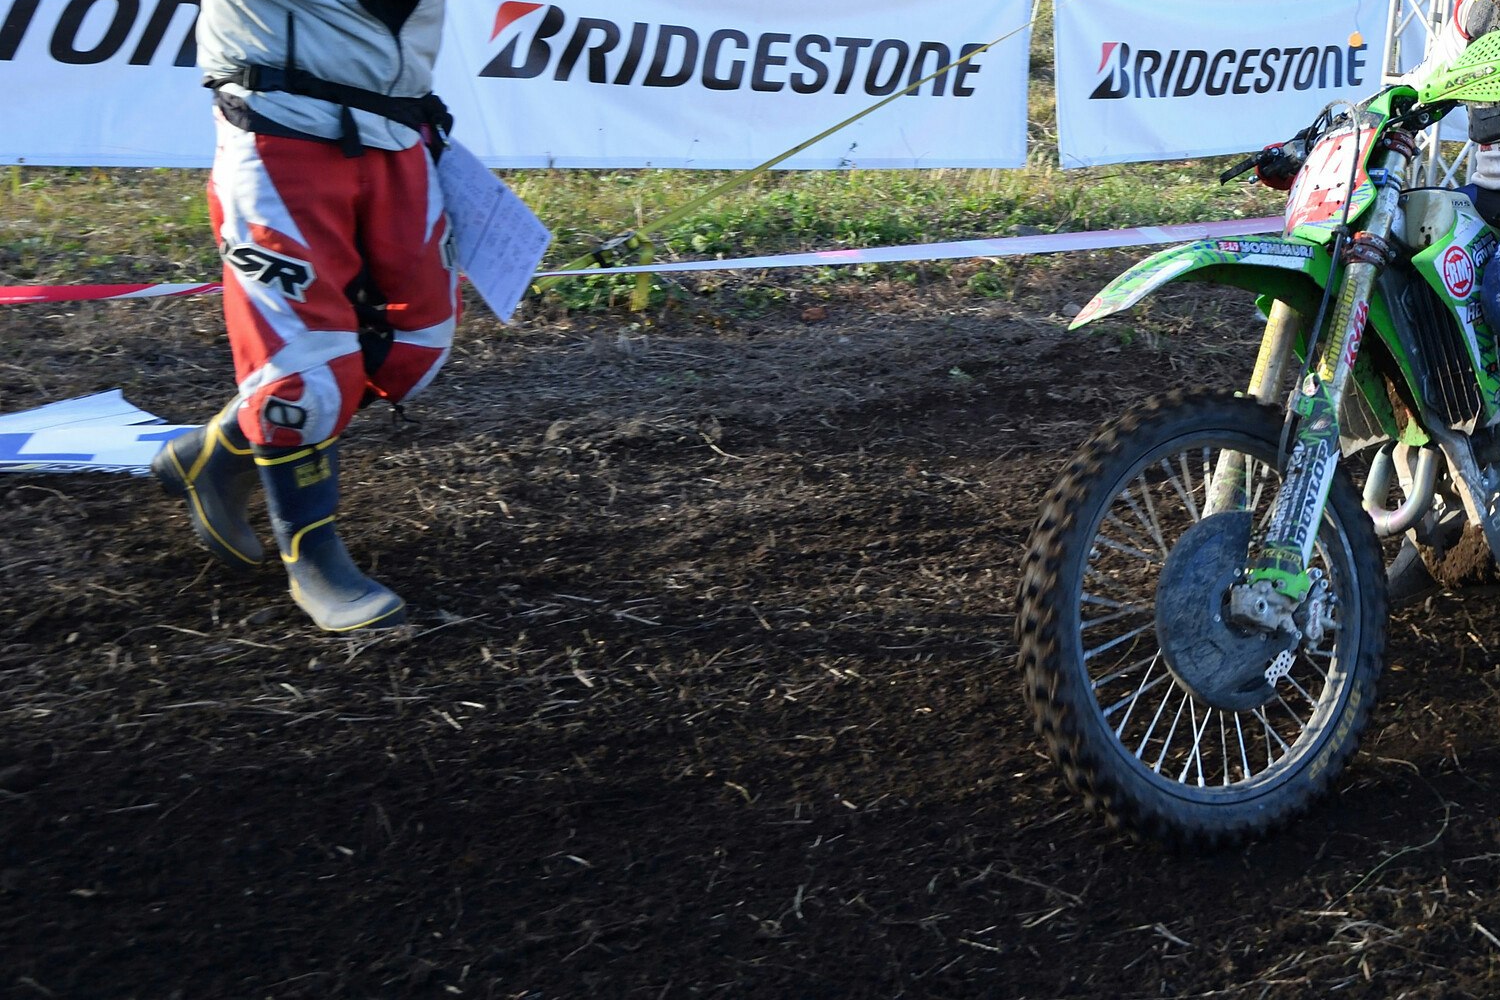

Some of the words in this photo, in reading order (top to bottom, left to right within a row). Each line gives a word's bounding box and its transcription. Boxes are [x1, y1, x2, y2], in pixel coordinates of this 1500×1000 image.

[478, 0, 988, 98] BRIDGESTONE
[1089, 42, 1368, 99] BRIDGESTONE
[219, 240, 318, 303] SR
[1239, 240, 1315, 258] YOSHIMURA
[1294, 438, 1329, 545] DUNLOP
